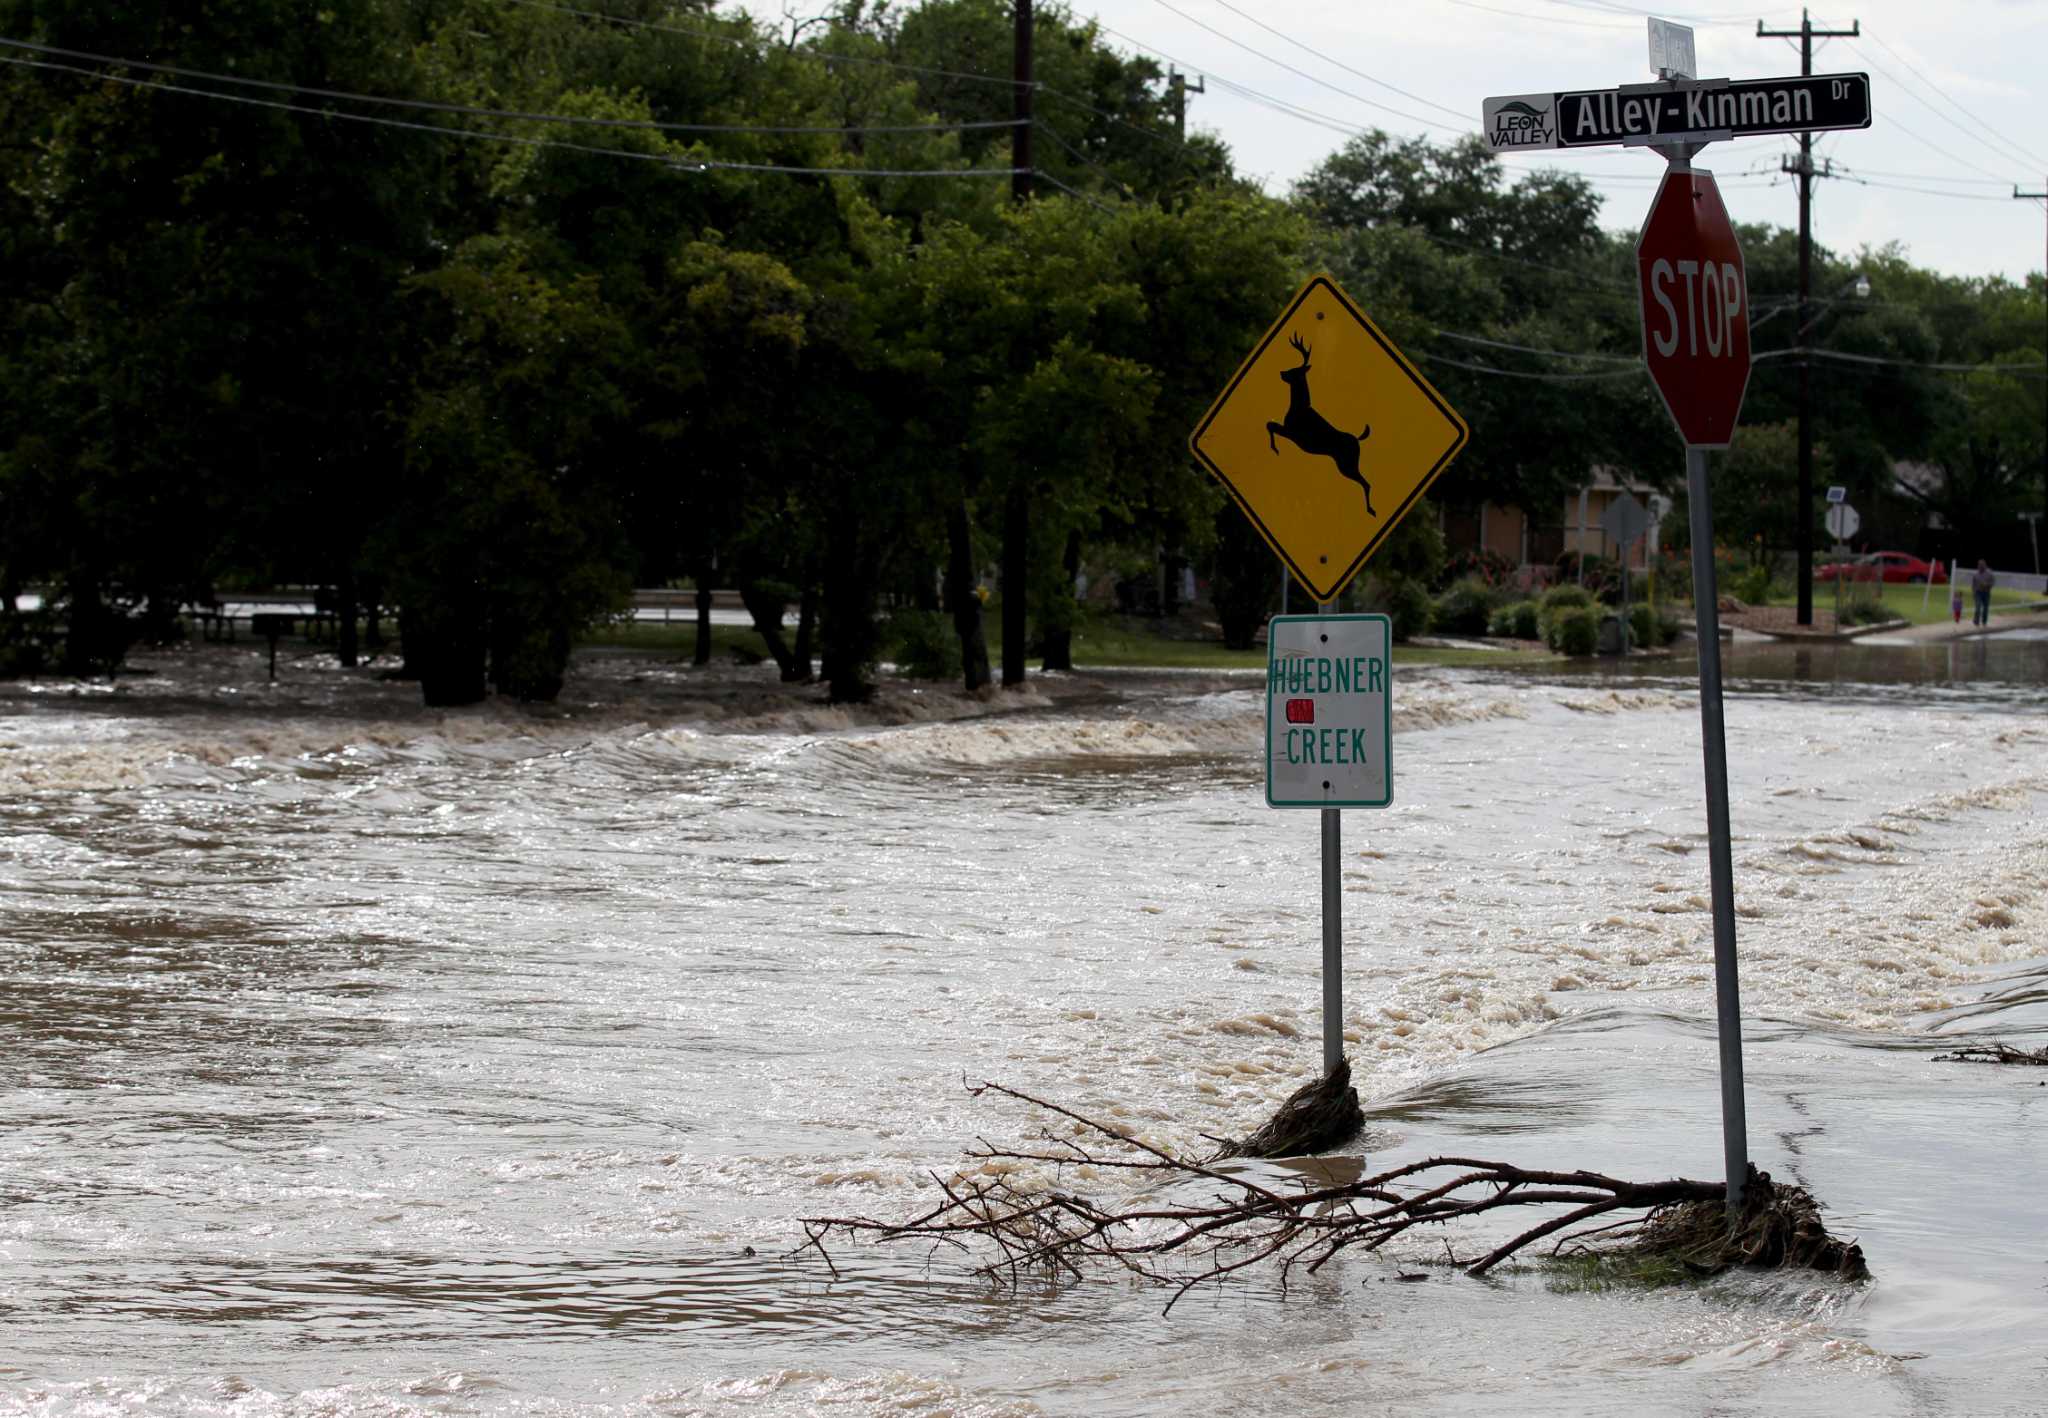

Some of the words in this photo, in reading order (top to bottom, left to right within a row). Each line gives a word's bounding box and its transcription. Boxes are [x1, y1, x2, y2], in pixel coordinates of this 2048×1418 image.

[1832, 80, 1850, 100] Dr
[1490, 128, 1553, 146] VALLEY
[1496, 115, 1544, 131] LEON
[1652, 259, 1741, 357] STOP
[1273, 658, 1383, 694] HUEBNER
[1287, 728, 1367, 764] CREEK
